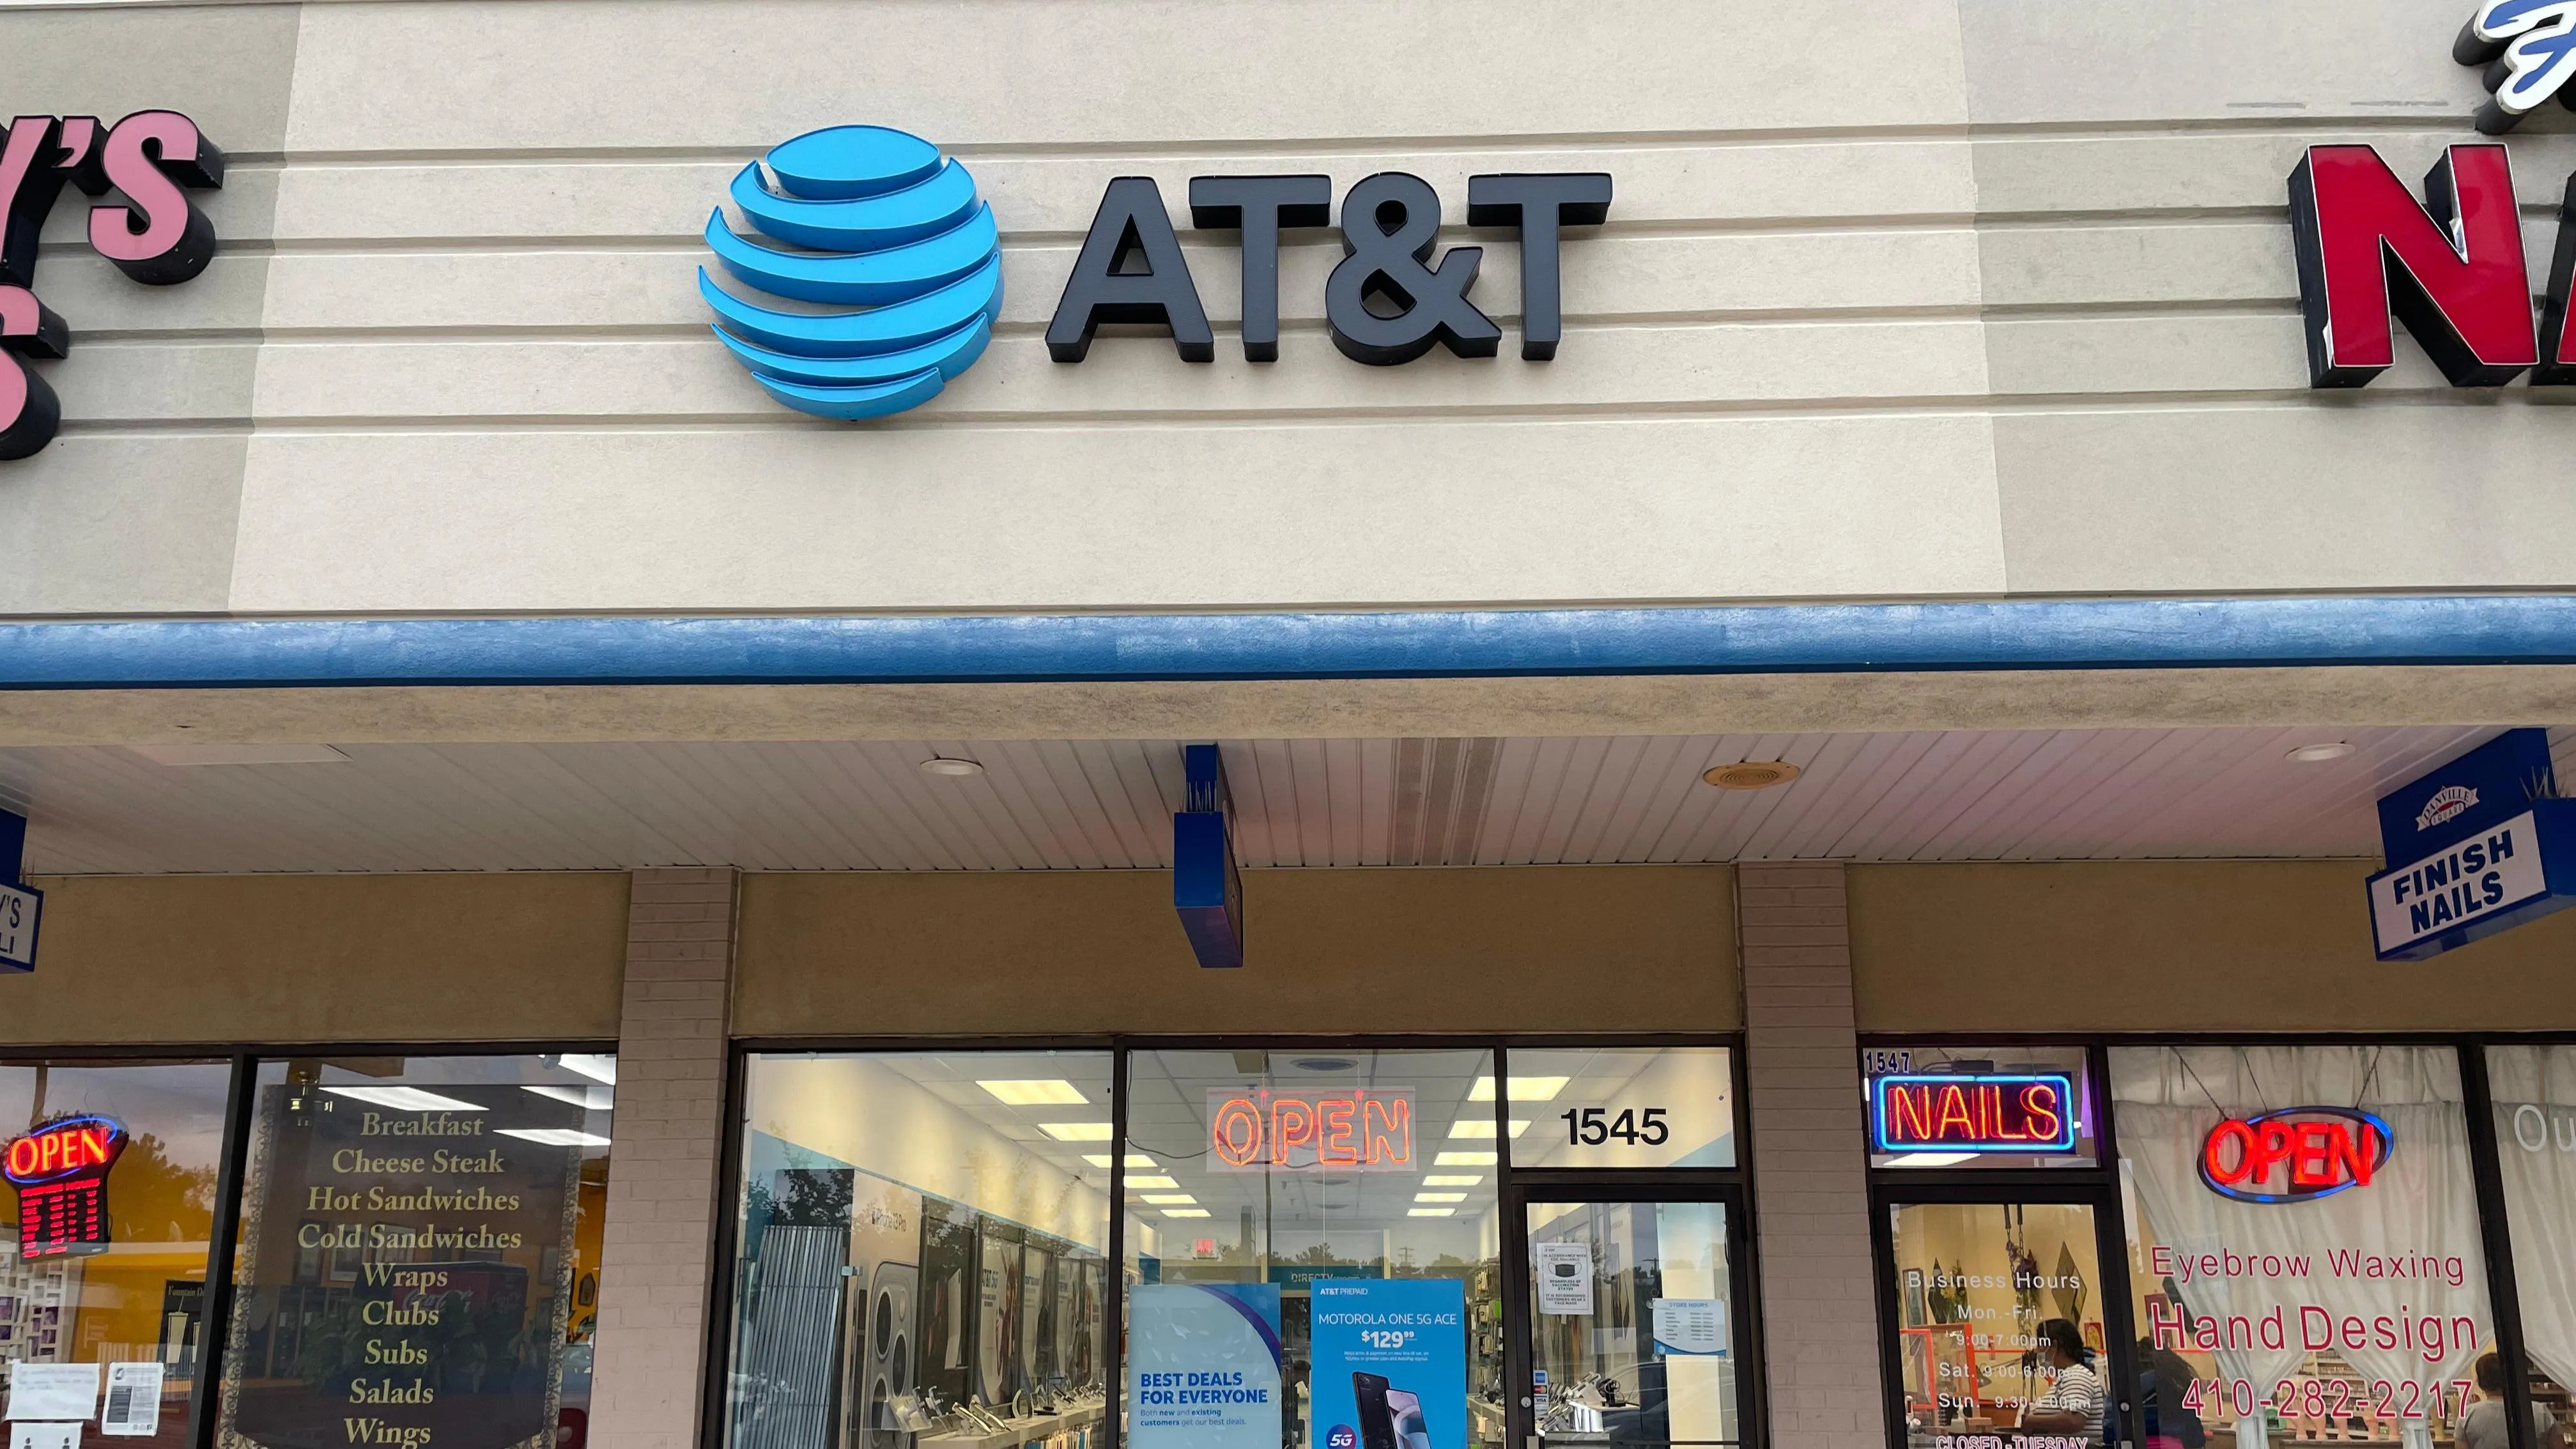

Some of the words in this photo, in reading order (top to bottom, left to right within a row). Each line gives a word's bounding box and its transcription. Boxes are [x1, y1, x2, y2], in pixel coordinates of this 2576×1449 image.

[1045, 171, 1612, 365] AT&T
[2288, 144, 2576, 388] N
[2393, 829, 2514, 905] FINISH
[2410, 871, 2503, 934] NAILS
[1866, 1051, 1911, 1073] 1547
[360, 1111, 484, 1136] Breakfast
[1890, 1084, 2059, 1140] NAILS
[1214, 1098, 1410, 1165] OPEN
[1561, 1108, 1669, 1146] 1545
[2514, 1104, 2576, 1152] Ou
[7, 1126, 107, 1176] OPEN
[332, 1148, 425, 1173] Cheese
[431, 1148, 505, 1173] Steak
[2205, 1119, 2374, 1186] OPEN
[306, 1186, 362, 1211] Hot
[367, 1186, 520, 1211] Sandwiches
[298, 1223, 362, 1248] Cold
[369, 1223, 522, 1248] Sandwiches
[362, 1262, 448, 1295] Wraps
[2150, 1245, 2311, 1284] Eyebrow
[2327, 1247, 2465, 1287] Waxing
[1340, 1287, 1368, 1296] PREPAID
[1908, 1271, 2006, 1289] Business
[2016, 1271, 2080, 1289] Hours
[362, 1300, 439, 1326] Clubs
[1318, 1314, 1386, 1324] MOTOROLA
[1389, 1314, 1414, 1324] ONE
[1416, 1314, 1431, 1324] 5G
[1434, 1314, 1457, 1324] ACE
[2150, 1302, 2287, 1351] Hand
[2299, 1304, 2478, 1363] Design
[364, 1339, 428, 1365] Subs
[1141, 1373, 1184, 1387] BEST
[1188, 1372, 1242, 1386] DEALS
[1940, 1362, 1977, 1378] Sat.
[1984, 1365, 2072, 1379] 9:00-6:00p
[349, 1377, 434, 1404] Salads
[1141, 1390, 1175, 1405] FOR
[1179, 1389, 1268, 1404] EVERYONE
[1938, 1393, 1980, 1408] Sun.
[2181, 1377, 2472, 1419] 410-282-2217
[1181, 1419, 1193, 1427] get
[1209, 1418, 1224, 1426] best
[1191, 1408, 1221, 1417] existing
[344, 1418, 431, 1449] Wings
[1329, 1434, 1354, 1446] 5G
